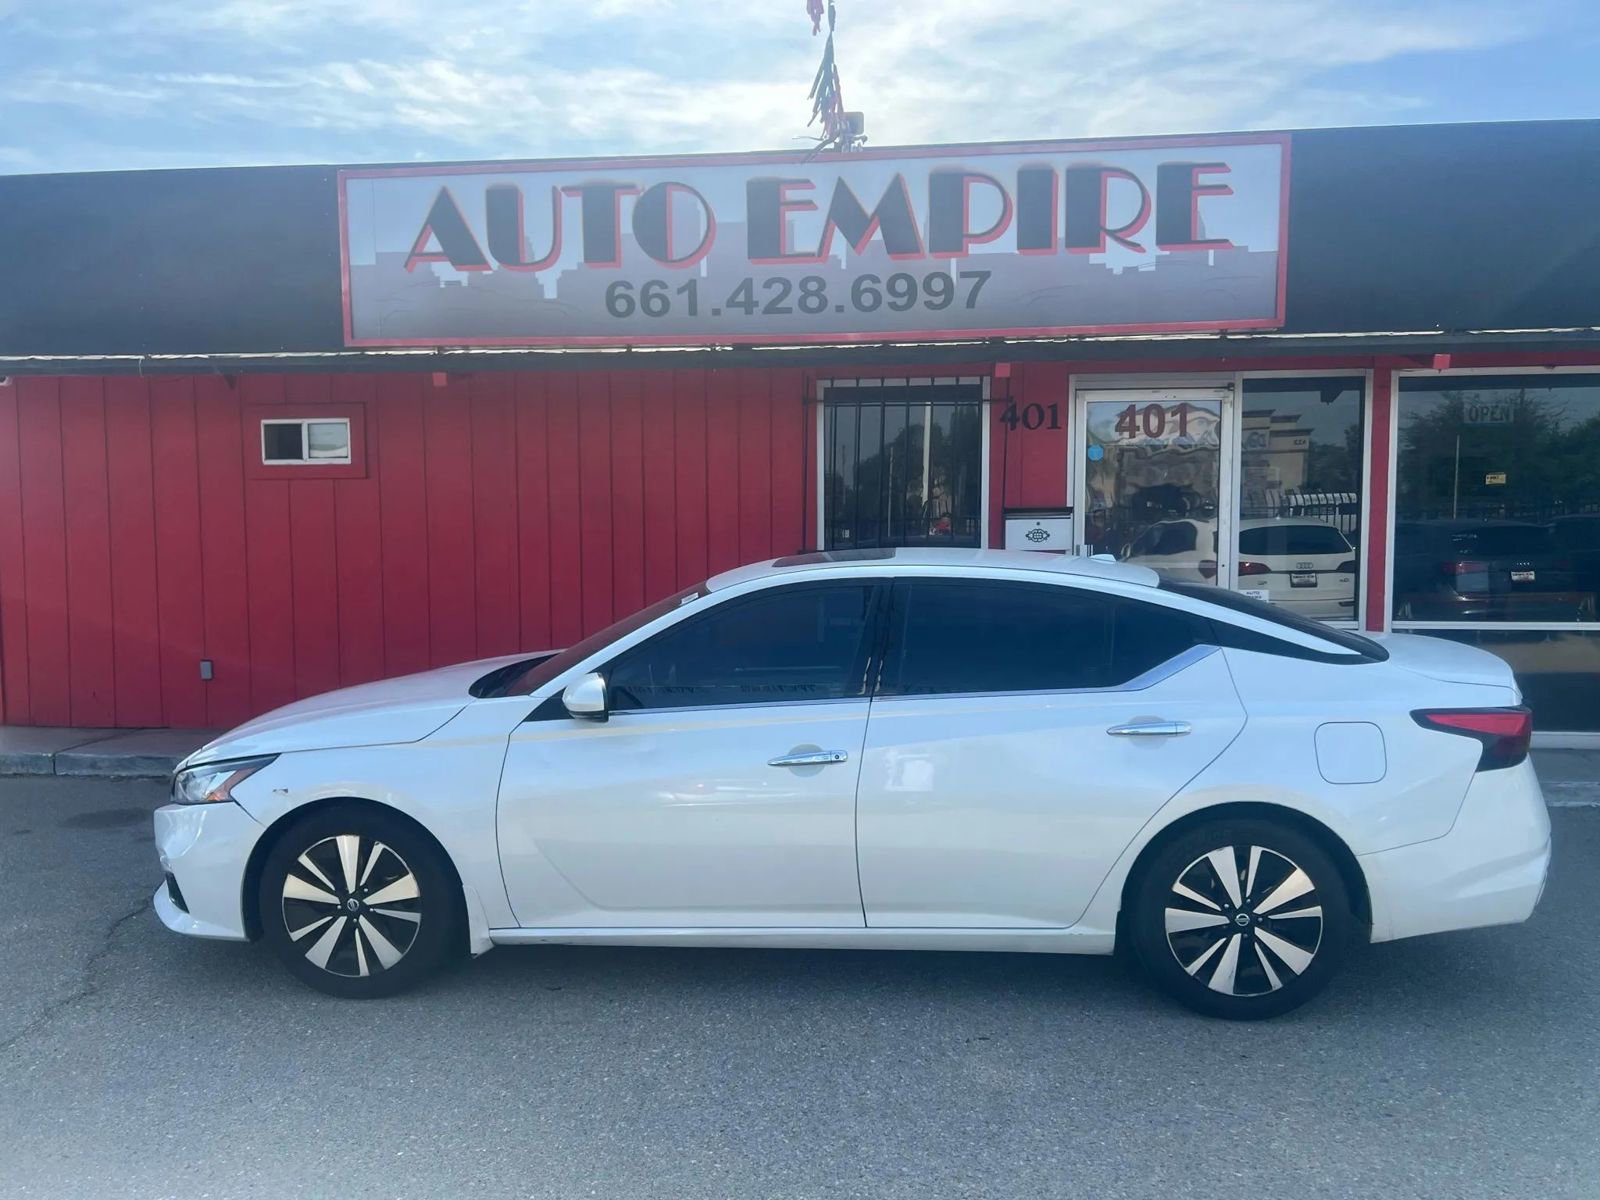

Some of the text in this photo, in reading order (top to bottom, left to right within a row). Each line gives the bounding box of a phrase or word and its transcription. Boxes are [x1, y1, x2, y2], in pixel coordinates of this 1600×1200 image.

[404, 162, 1234, 272] AUTO EMPIRE
[606, 270, 991, 318] 661.428.6997
[1000, 402, 1062, 431] 401
[1115, 403, 1189, 439] 401
[1469, 405, 1510, 422] OPEN
